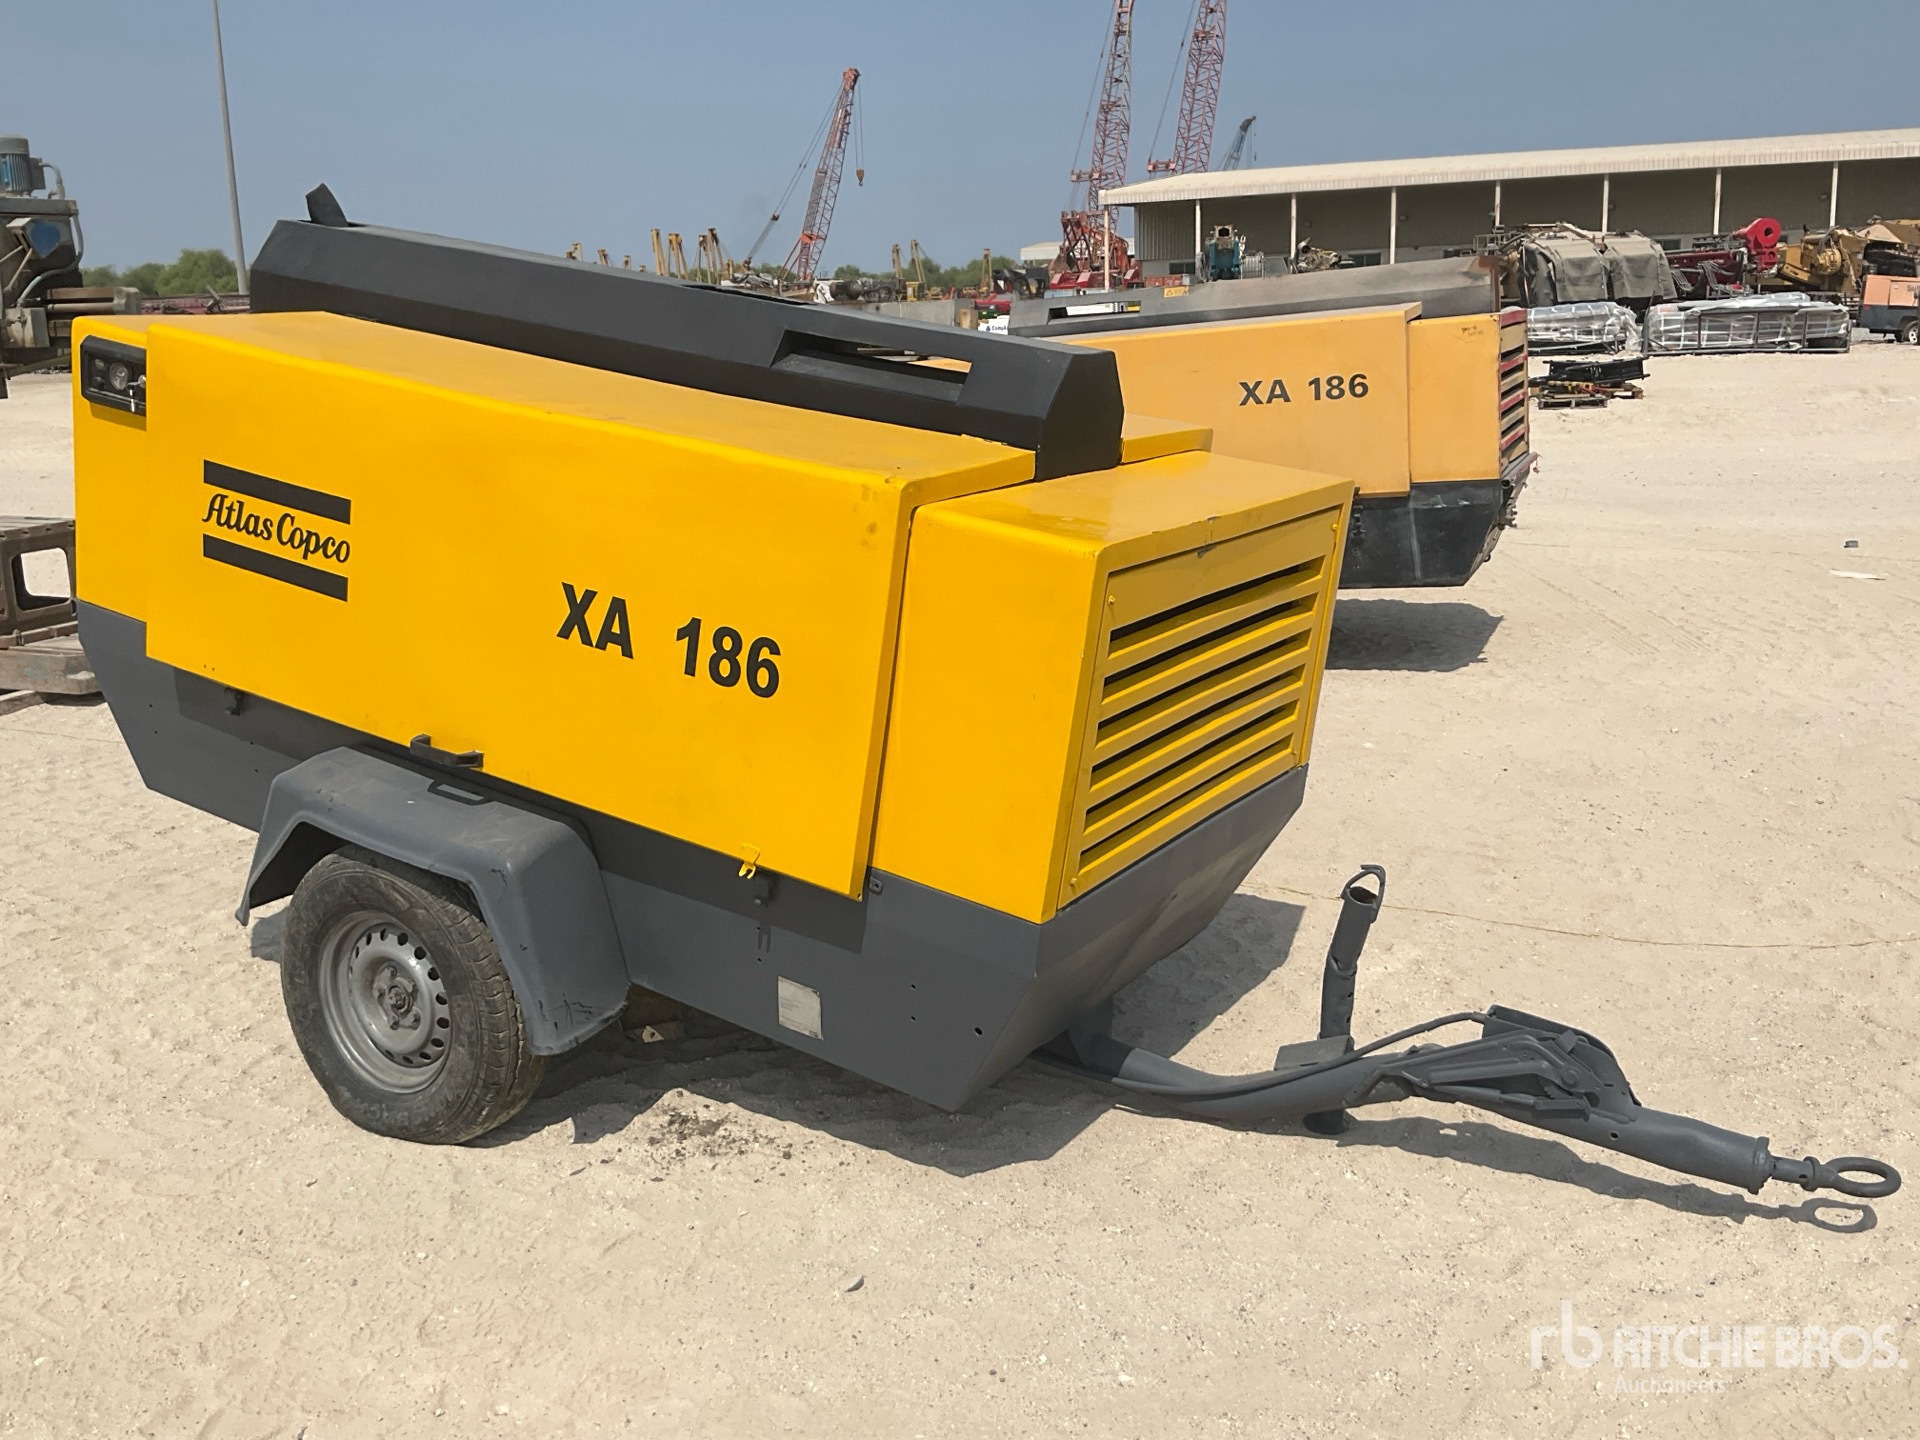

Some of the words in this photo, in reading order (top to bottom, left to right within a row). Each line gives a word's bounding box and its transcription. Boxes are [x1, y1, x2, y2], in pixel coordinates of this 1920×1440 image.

[1238, 379, 1291, 406] XA
[1308, 373, 1369, 401] 186
[202, 493, 274, 541] Atlas
[276, 512, 351, 563] Copco
[556, 581, 634, 660] XA
[675, 616, 781, 698] 186
